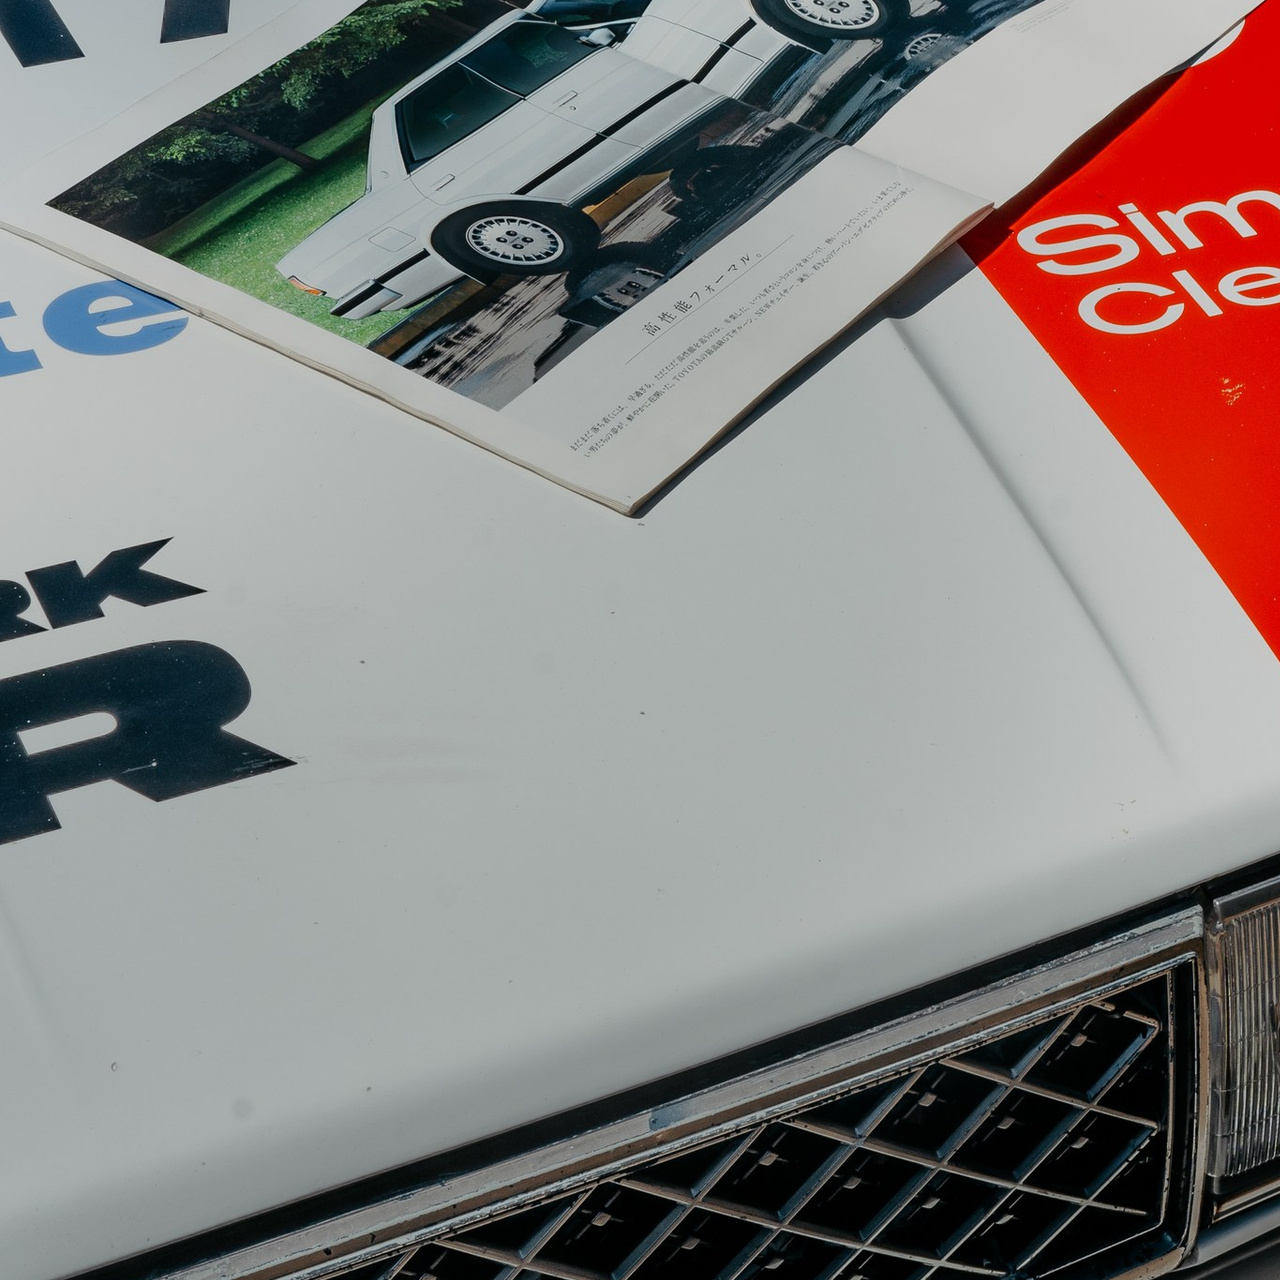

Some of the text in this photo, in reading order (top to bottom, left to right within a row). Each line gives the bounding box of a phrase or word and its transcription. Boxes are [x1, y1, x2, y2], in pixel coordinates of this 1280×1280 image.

[641, 252, 763, 337] 高性能フォーマル。
